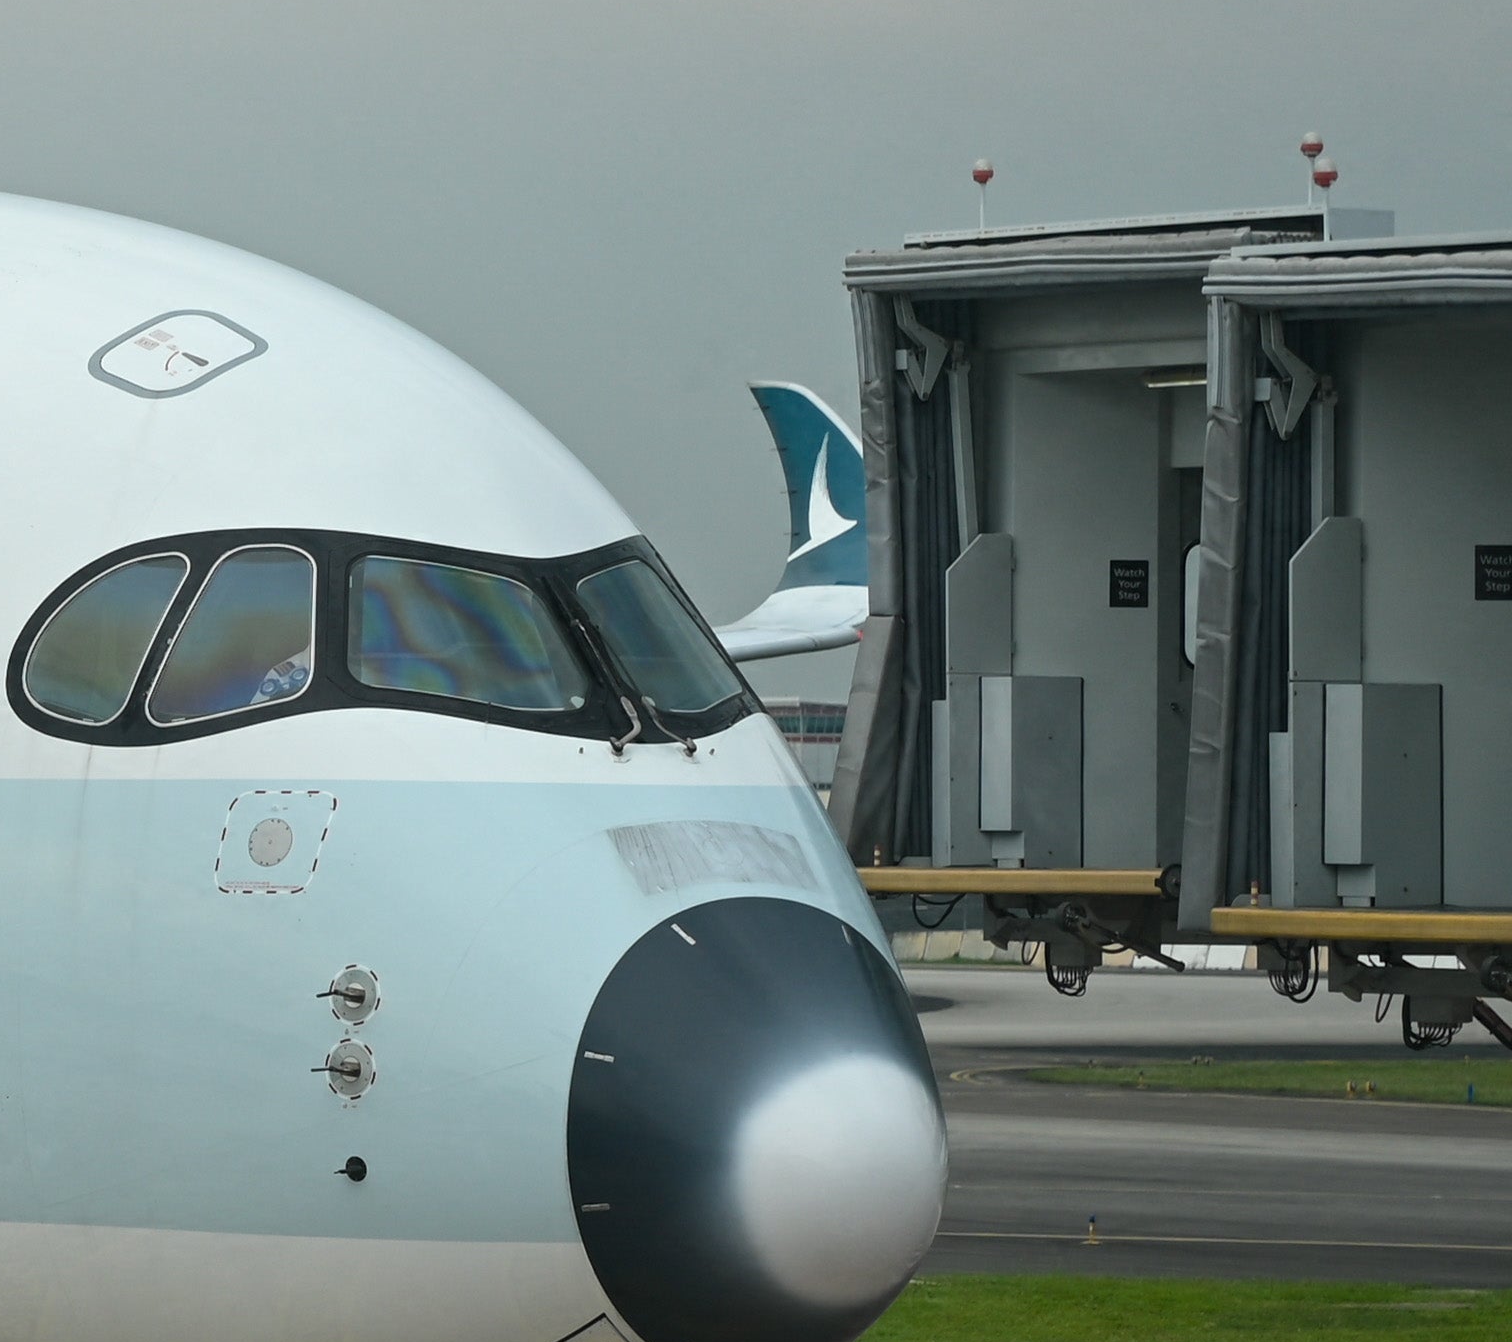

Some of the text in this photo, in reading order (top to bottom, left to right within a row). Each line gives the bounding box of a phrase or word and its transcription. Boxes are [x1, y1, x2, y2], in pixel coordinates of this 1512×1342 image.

[1114, 568, 1145, 577] Watch
[1119, 580, 1141, 589] Your
[1485, 581, 1511, 593] Step
[1119, 590, 1141, 602] Step
